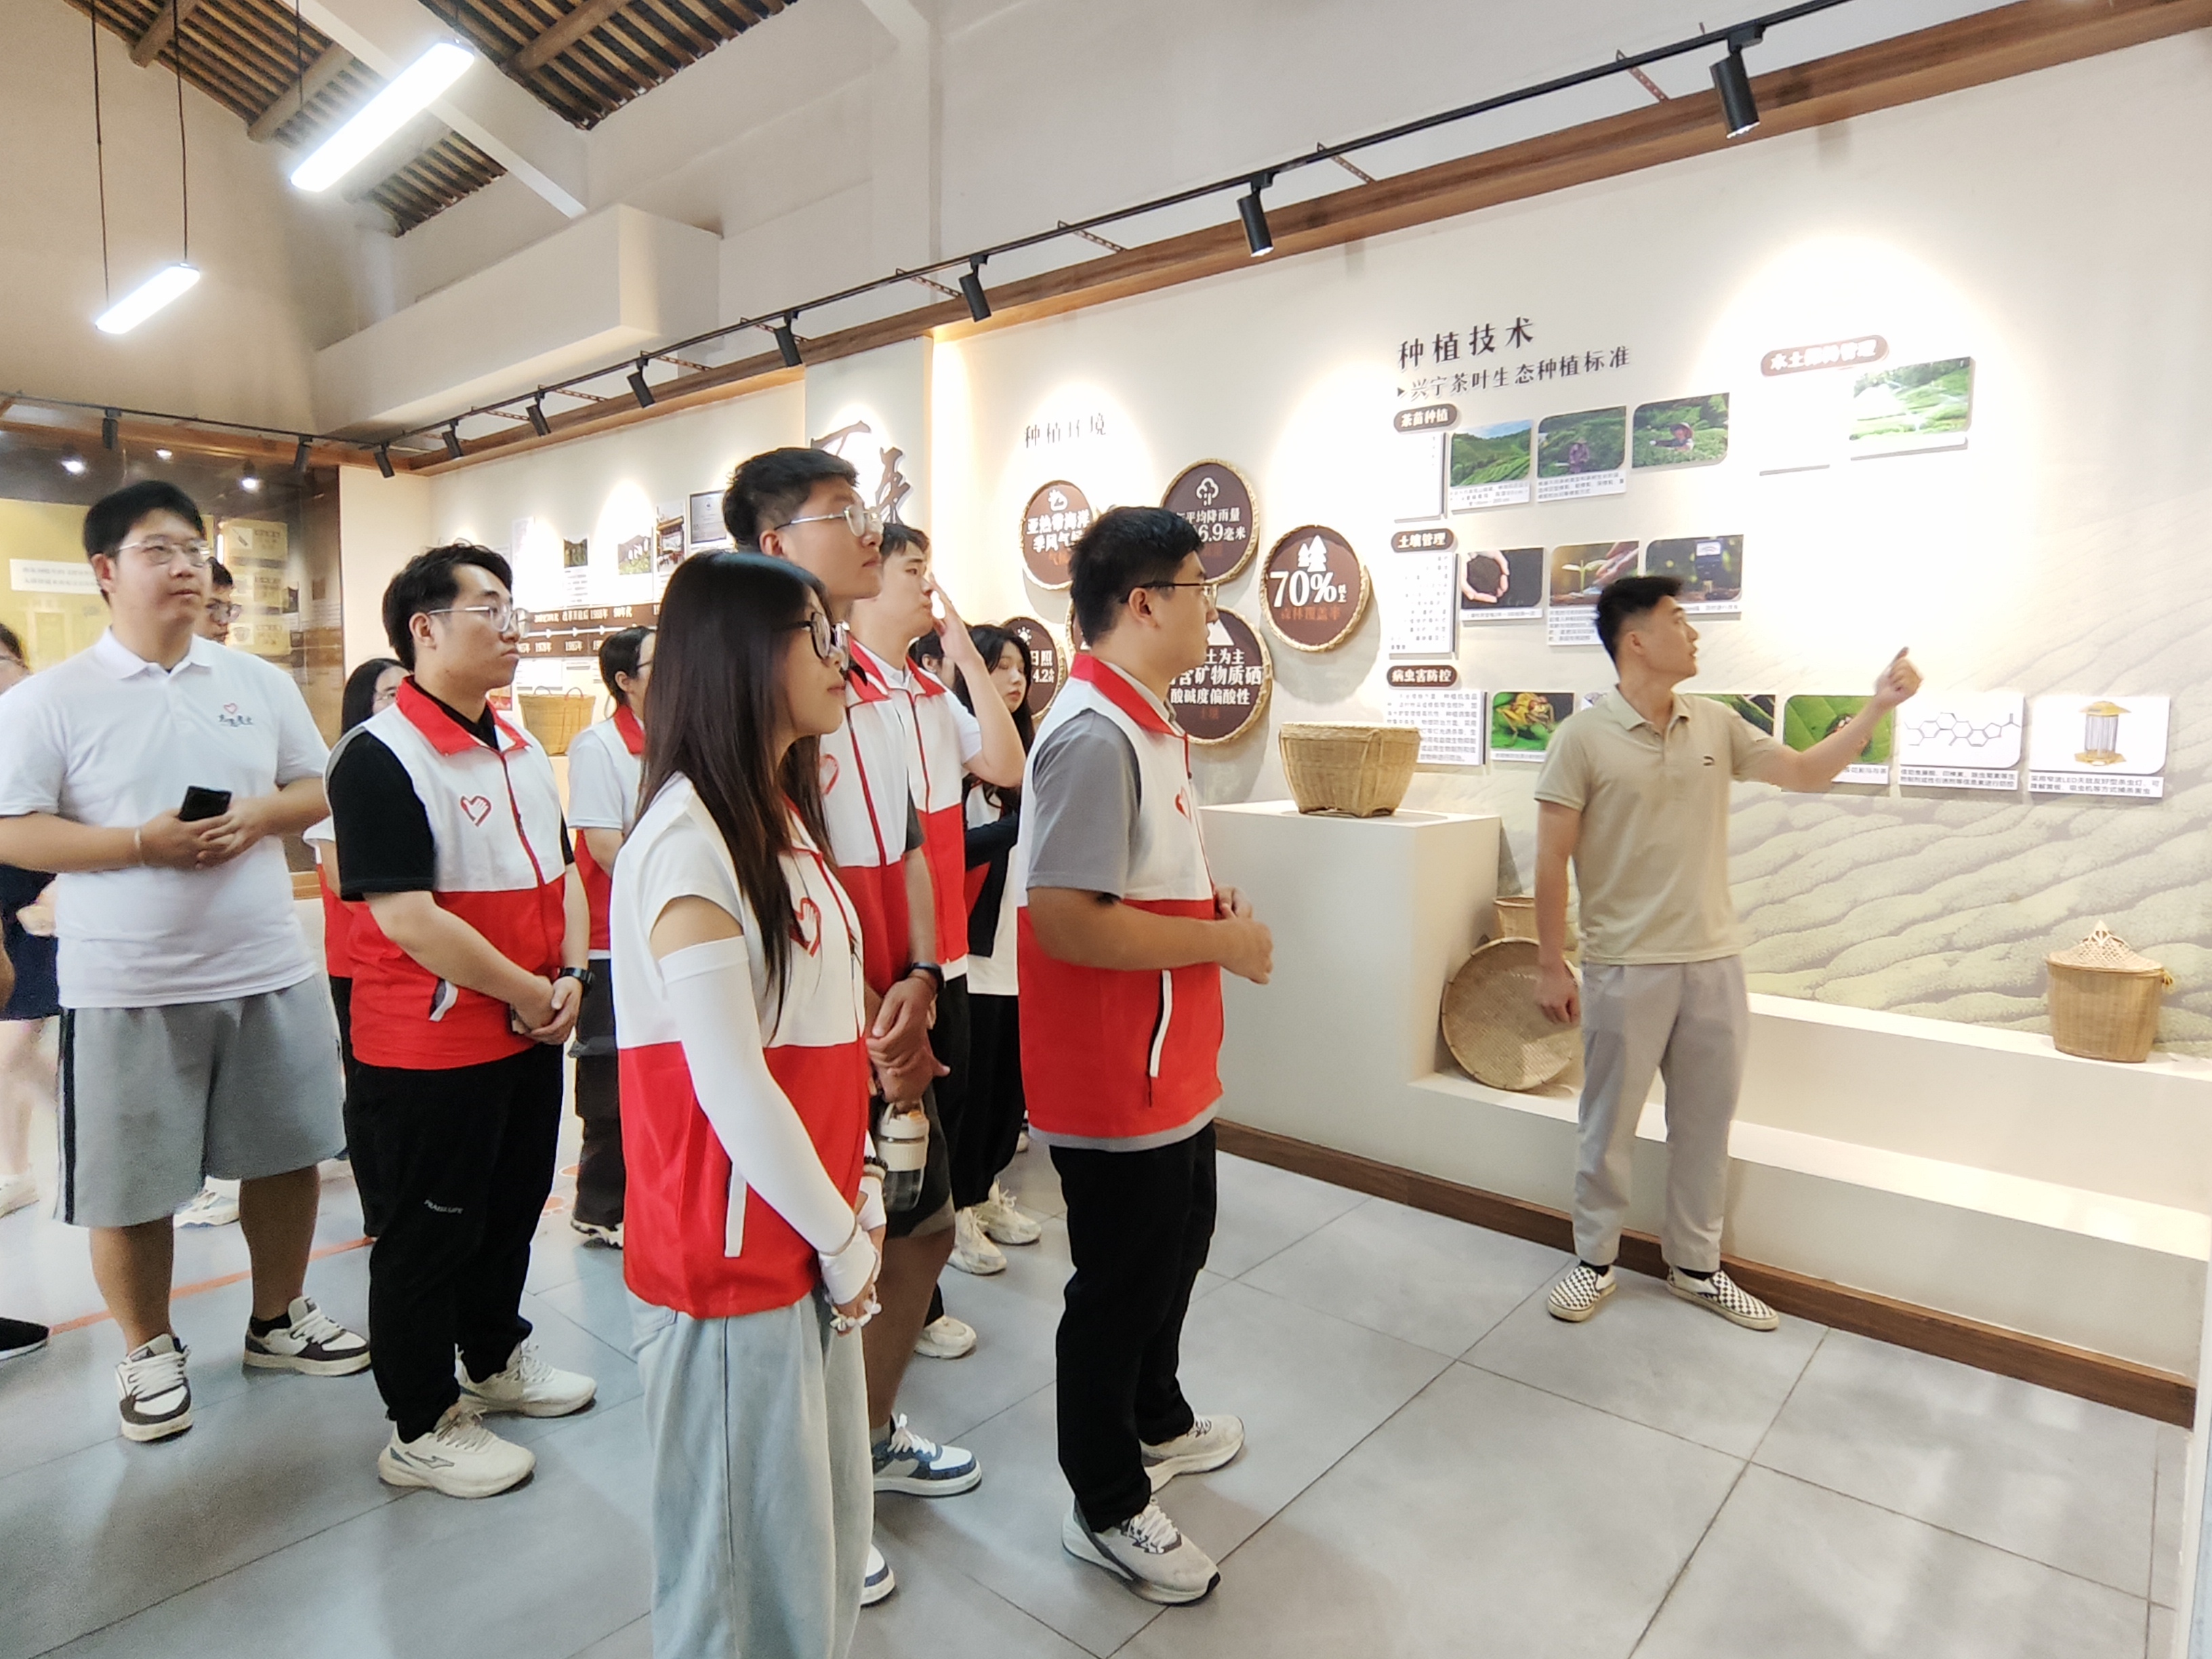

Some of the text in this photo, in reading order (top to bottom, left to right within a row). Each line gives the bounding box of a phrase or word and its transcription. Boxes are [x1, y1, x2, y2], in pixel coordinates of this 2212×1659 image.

[1398, 316, 1534, 370] 种植技术
[1410, 345, 1630, 398] 兴宁茶叶生态种植标准
[1269, 570, 1337, 608] 70%
[1391, 669, 1452, 683] 病虫害防控
[1170, 687, 1250, 705] 酸碱度偏酸性
